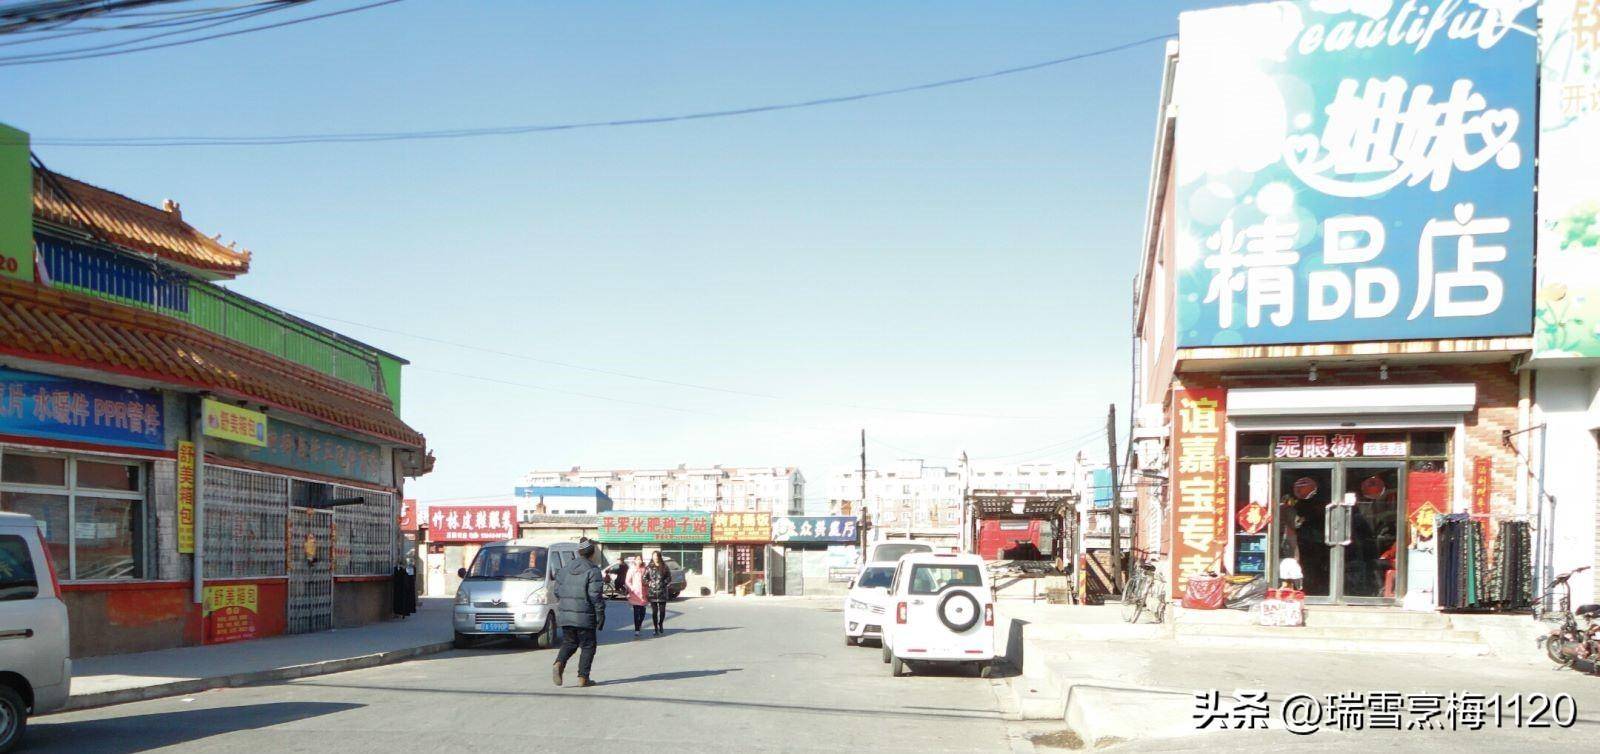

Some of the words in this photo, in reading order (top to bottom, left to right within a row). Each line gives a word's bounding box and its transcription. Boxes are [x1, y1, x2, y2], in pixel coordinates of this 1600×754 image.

[1281, 75, 1521, 198] 姐妹
[1203, 203, 1511, 329] 精品店
[1274, 434, 1358, 457] 无限极
